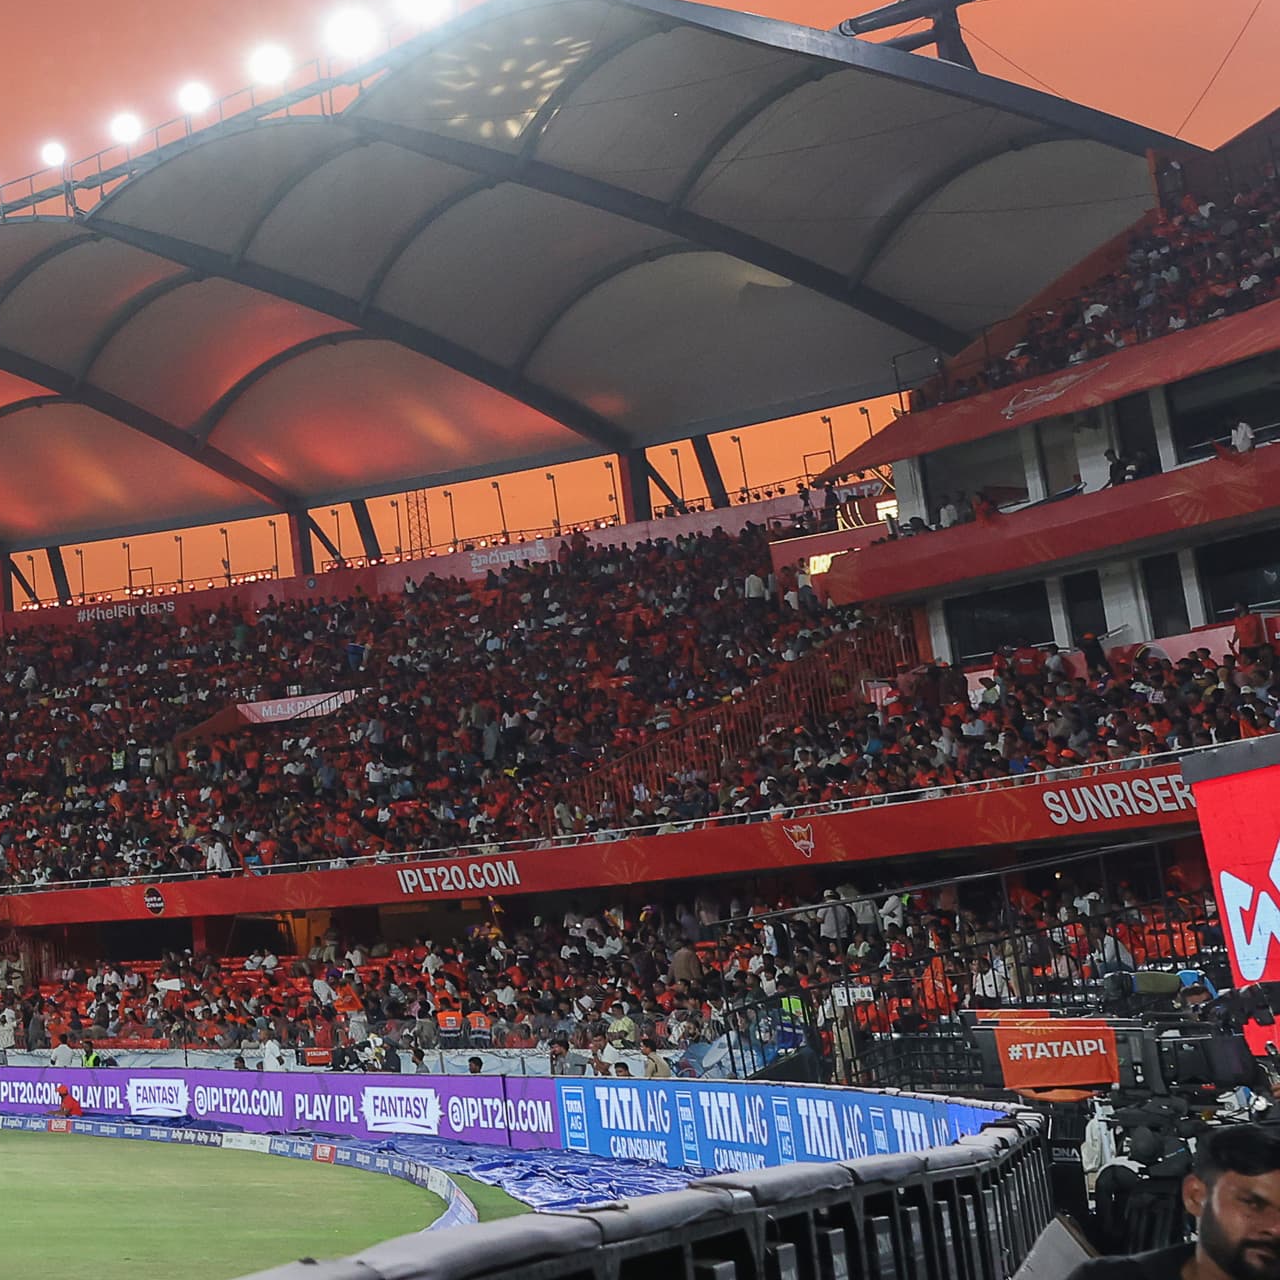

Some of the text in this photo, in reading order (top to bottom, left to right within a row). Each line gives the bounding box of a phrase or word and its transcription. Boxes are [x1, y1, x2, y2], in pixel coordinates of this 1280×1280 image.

[1042, 775, 1197, 825] SUNRISER
[397, 861, 520, 893] IPLT20.COM
[1008, 1038, 1107, 1061] #TATAIPL
[72, 1085, 283, 1116] PLAY IPL FANTASY @IPLT20.COM
[295, 1093, 554, 1133] PLAY IPL FANTASY @IPLT20.COM
[595, 1086, 671, 1134] TATA AIG
[699, 1091, 768, 1147] TATA AIG
[796, 1098, 868, 1161] TATA AIG
[610, 1136, 668, 1164] CAR INSURANCE
